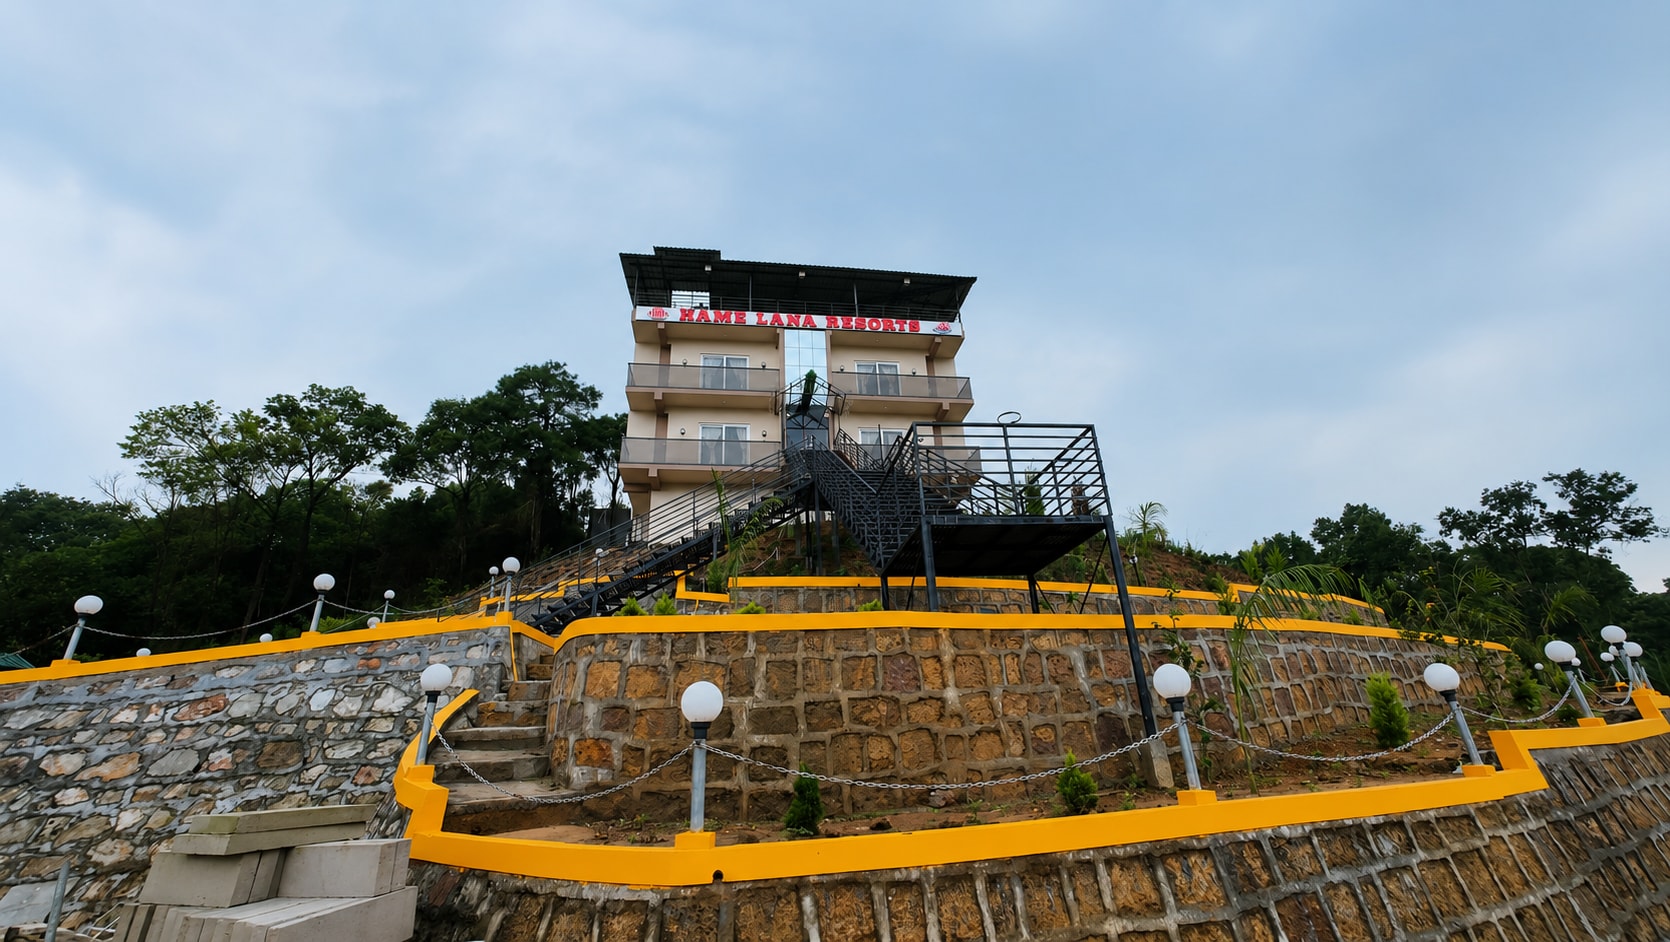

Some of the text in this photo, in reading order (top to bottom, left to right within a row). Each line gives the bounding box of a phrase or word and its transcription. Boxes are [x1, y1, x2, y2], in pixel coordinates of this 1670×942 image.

[679, 308, 921, 333] HAME LANA RESORTS
